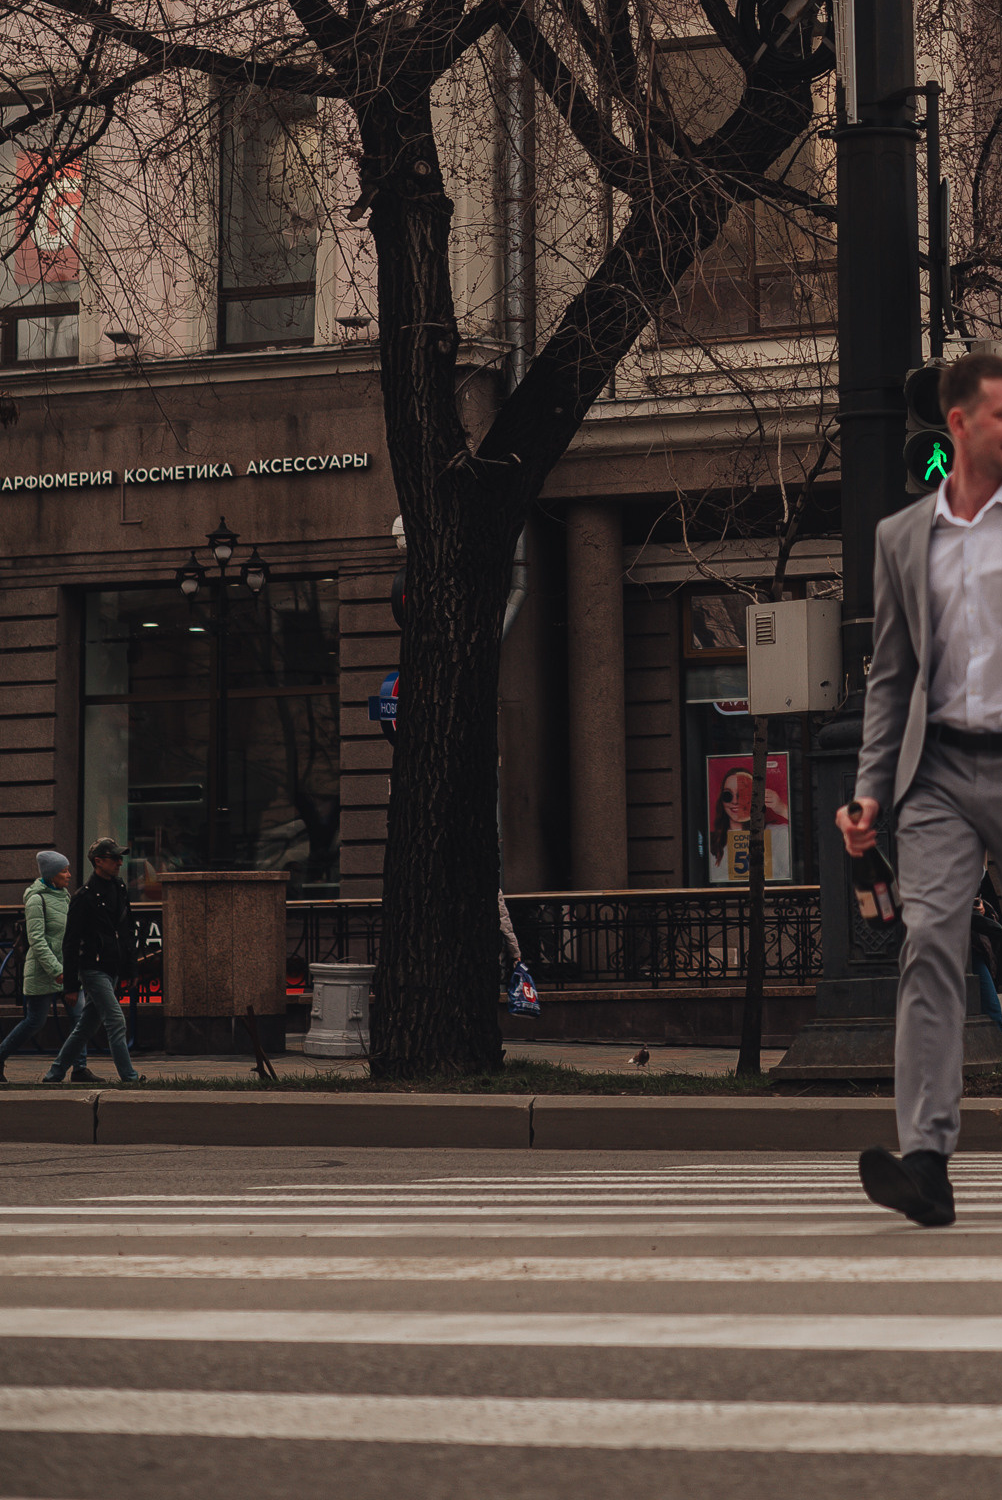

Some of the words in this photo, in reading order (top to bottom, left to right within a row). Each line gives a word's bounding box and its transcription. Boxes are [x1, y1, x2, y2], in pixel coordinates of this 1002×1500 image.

[0, 470, 113, 491] АРФЮМЕРИЯ
[124, 462, 233, 484] КОСМЕТИКА
[246, 452, 368, 475] АКСЕССУАРЫ
[733, 834, 750, 842] СОЧ
[733, 851, 750, 874] 5
